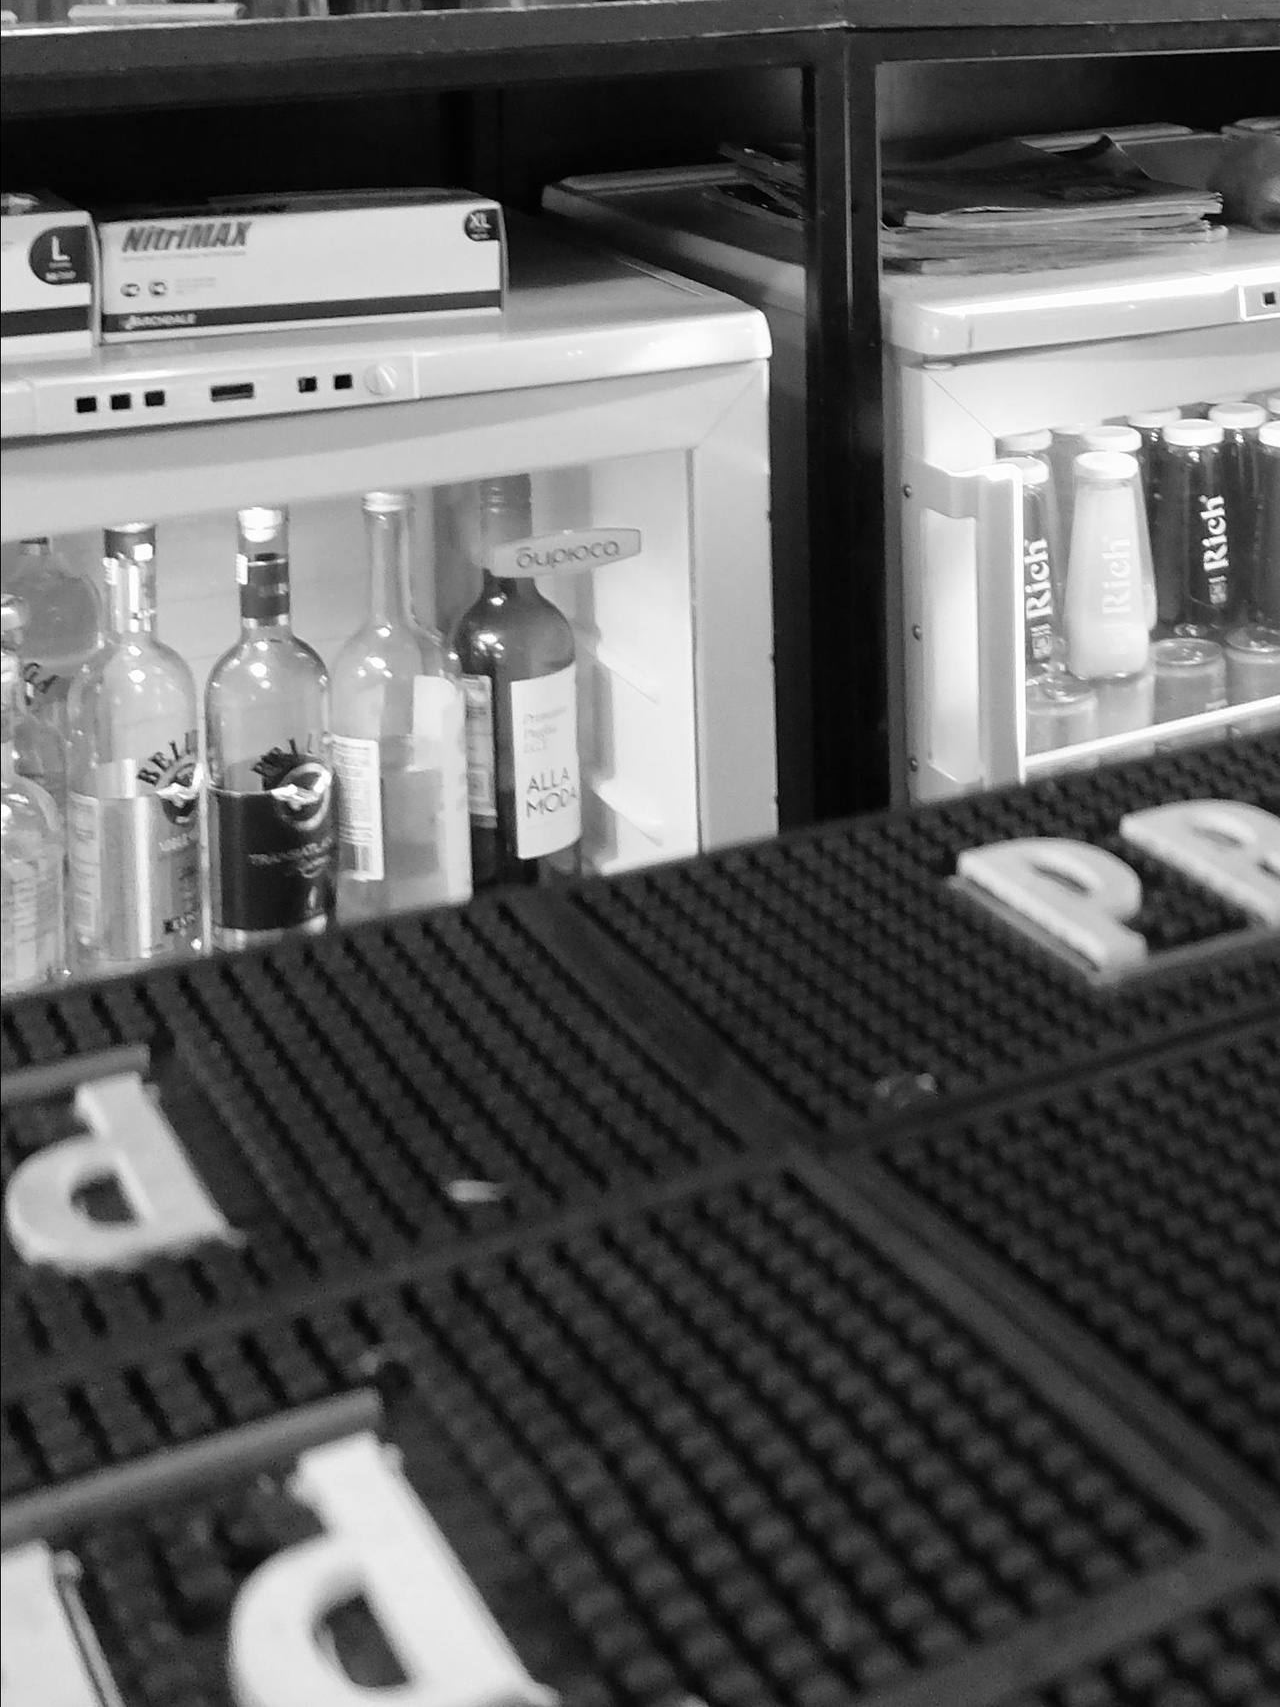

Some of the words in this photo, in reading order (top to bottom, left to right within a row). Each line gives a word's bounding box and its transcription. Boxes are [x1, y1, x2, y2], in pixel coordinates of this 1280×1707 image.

[51, 235, 71, 261] L
[122, 220, 252, 252] NitriMAX
[1202, 495, 1227, 572] Rich
[1025, 537, 1054, 620] Rich
